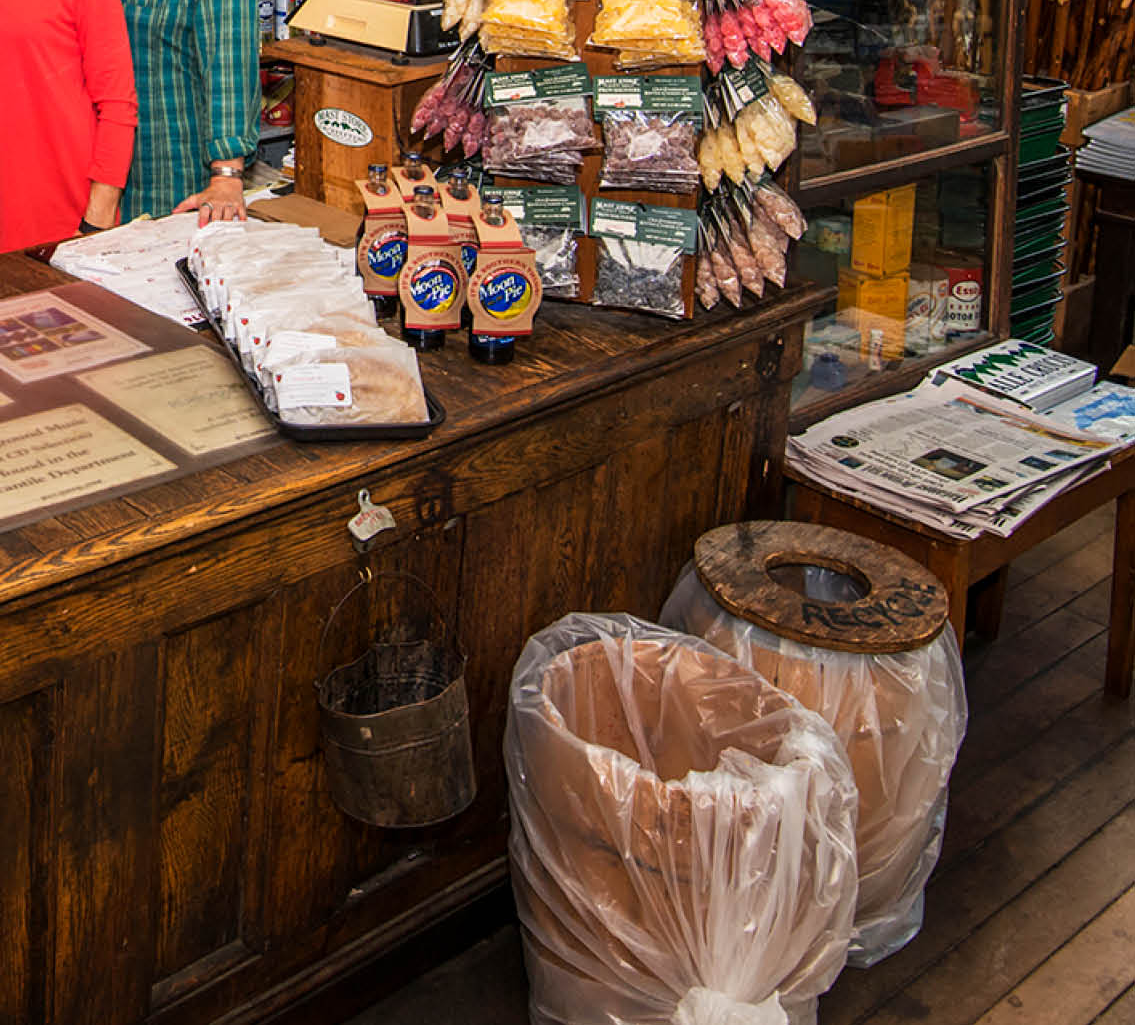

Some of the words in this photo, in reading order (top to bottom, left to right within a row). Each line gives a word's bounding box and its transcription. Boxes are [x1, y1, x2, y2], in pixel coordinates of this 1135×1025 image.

[368, 244, 401, 264] Moon
[411, 273, 443, 296] Moon
[432, 283, 451, 300] Pie
[480, 276, 515, 300] Moon
[505, 284, 522, 302] Pie
[45, 417, 88, 435] Music
[0, 458, 45, 478] found
[48, 455, 63, 466] in
[66, 447, 89, 462] the
[6, 446, 30, 460] CD
[48, 450, 136, 479] Department
